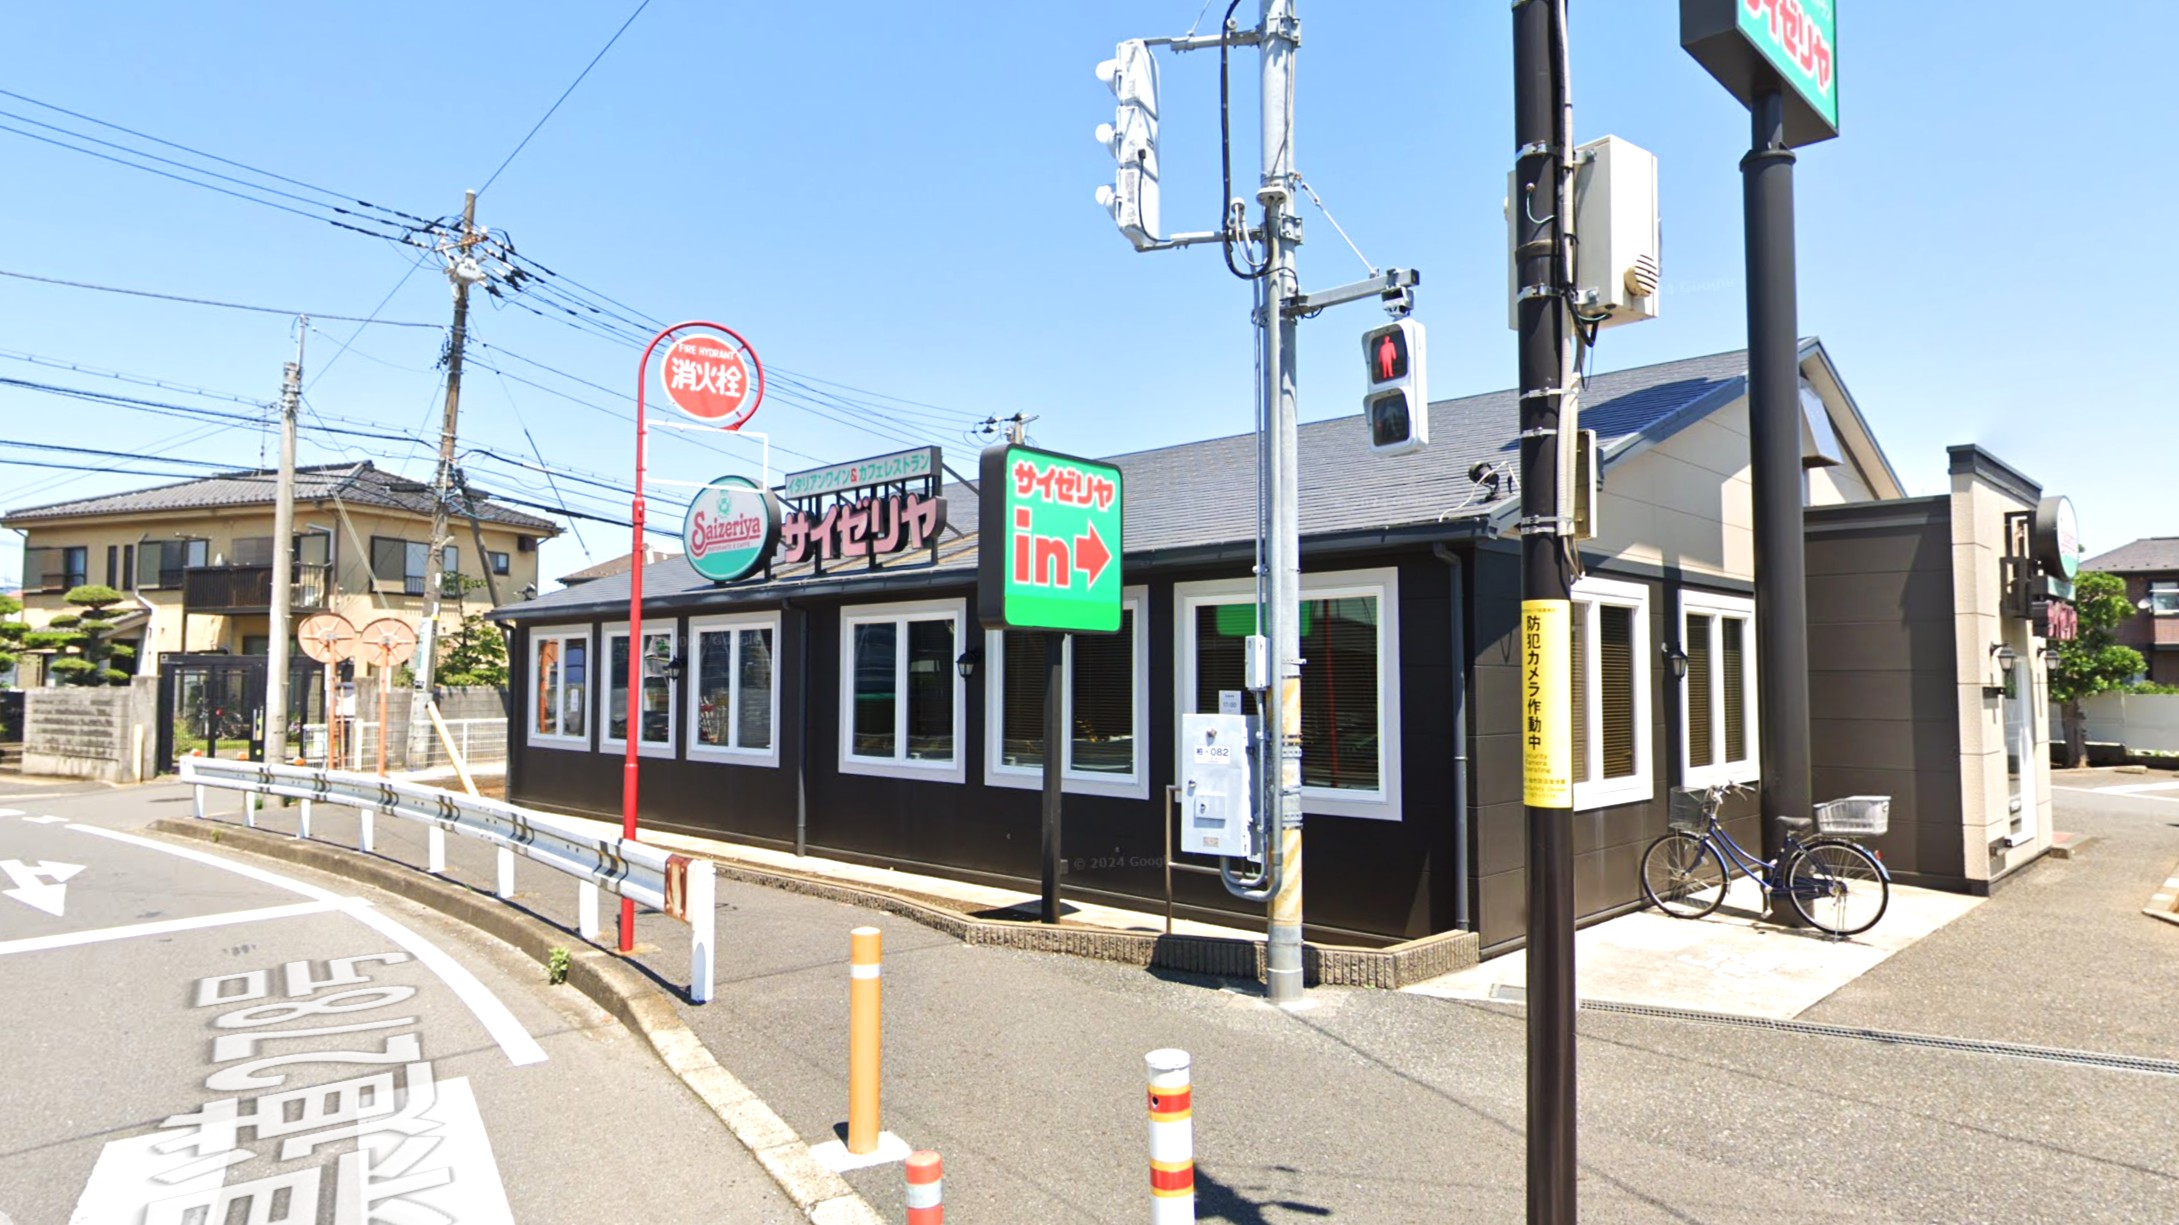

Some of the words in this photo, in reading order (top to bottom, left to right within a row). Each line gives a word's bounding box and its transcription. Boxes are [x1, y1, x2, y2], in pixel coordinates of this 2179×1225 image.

[671, 357, 742, 397] 消火栓
[678, 344, 697, 355] FIRE
[699, 346, 735, 360] HYDRANT
[1013, 460, 1115, 511] サイゼリヤ
[691, 510, 761, 557] Saizeriya
[781, 492, 938, 563] サイゼリヤ
[1014, 507, 1070, 587] in
[1526, 615, 1542, 750] 防犯カメラ作動中
